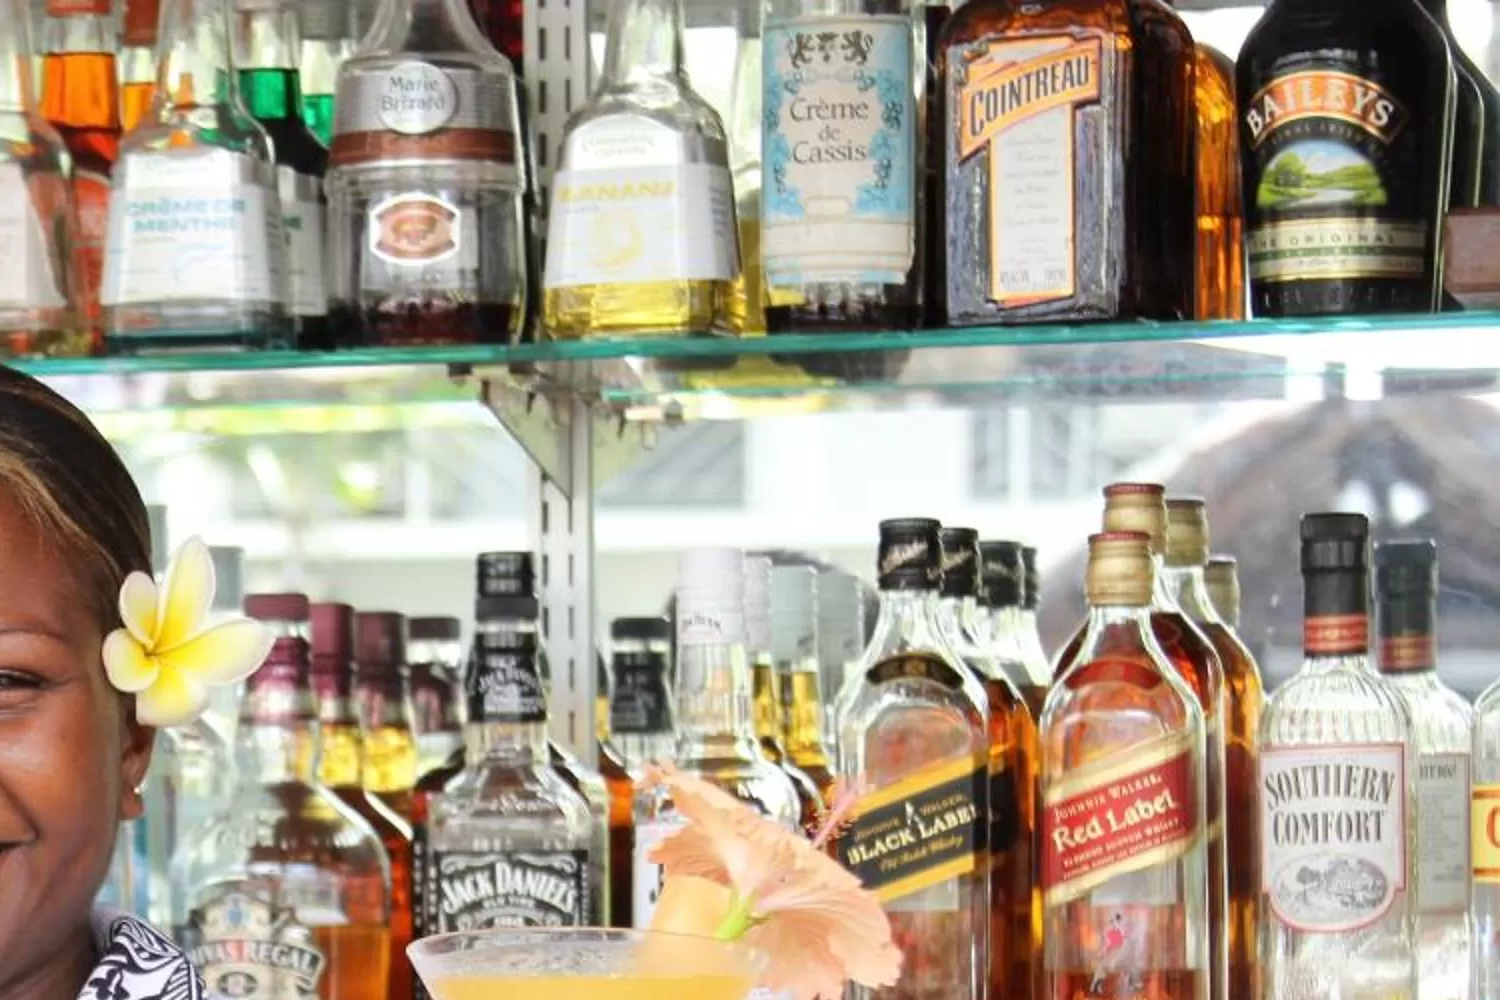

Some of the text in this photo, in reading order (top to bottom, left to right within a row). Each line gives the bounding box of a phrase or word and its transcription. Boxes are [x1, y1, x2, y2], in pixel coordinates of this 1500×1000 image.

[389, 73, 439, 92] Marie
[969, 55, 1090, 137] COINTREAU
[381, 95, 446, 113] Brizard
[789, 97, 869, 123] Crème
[1247, 75, 1394, 139] BAILEYS
[817, 124, 841, 141] de
[791, 139, 868, 164] Cassis
[1289, 232, 1396, 247] ORIGINAL
[1265, 763, 1396, 812] SOUTHERN
[846, 802, 978, 866] BLACK LABEL
[1052, 787, 1180, 854] Red Label
[1273, 809, 1386, 848] COMFORT
[441, 868, 495, 914] JACK
[250, 940, 321, 976] REGAL
